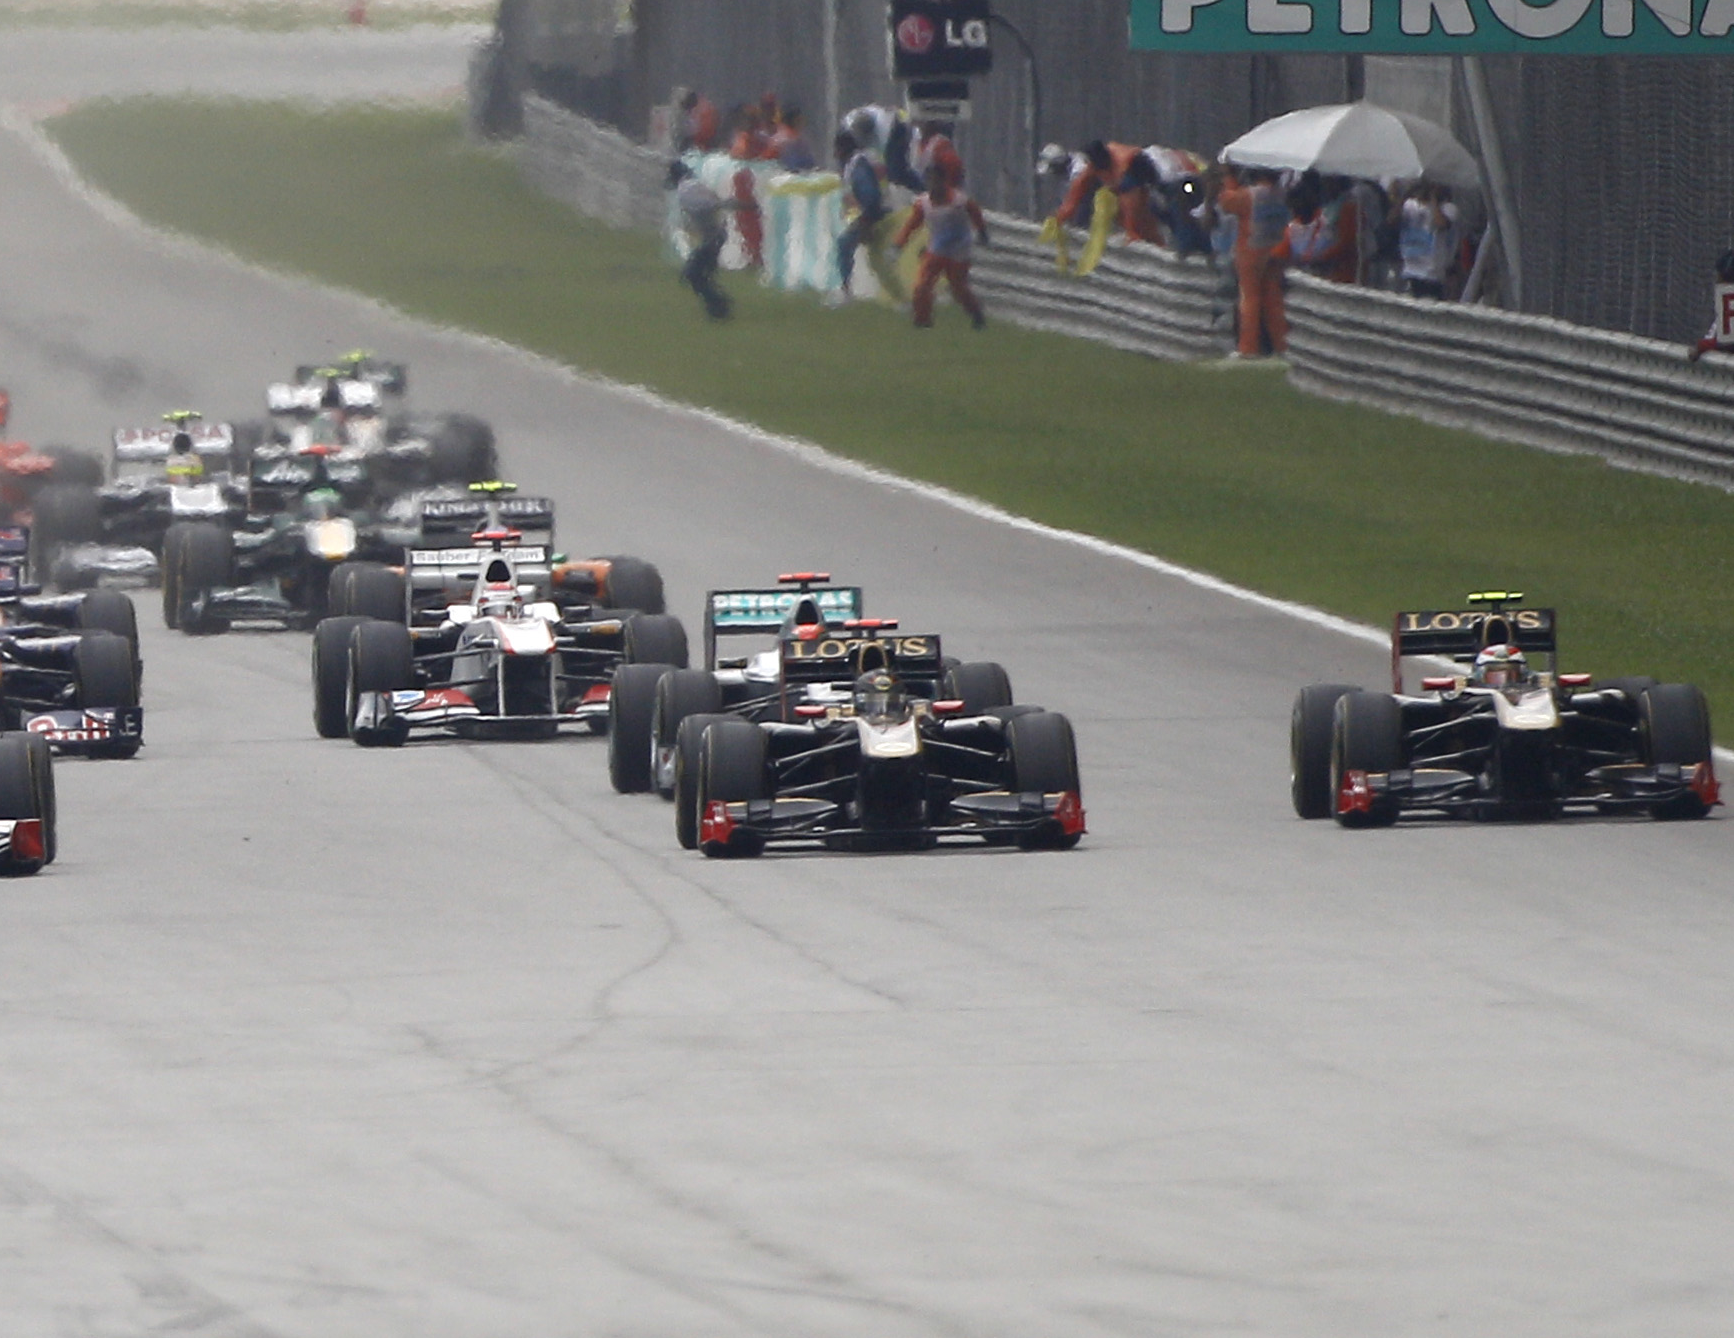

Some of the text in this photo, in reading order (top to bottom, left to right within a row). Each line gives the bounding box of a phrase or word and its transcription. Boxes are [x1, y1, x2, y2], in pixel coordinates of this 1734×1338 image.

[945, 18, 987, 48] LG
[713, 590, 853, 612] PETROAS
[1407, 611, 1541, 631] LOS
